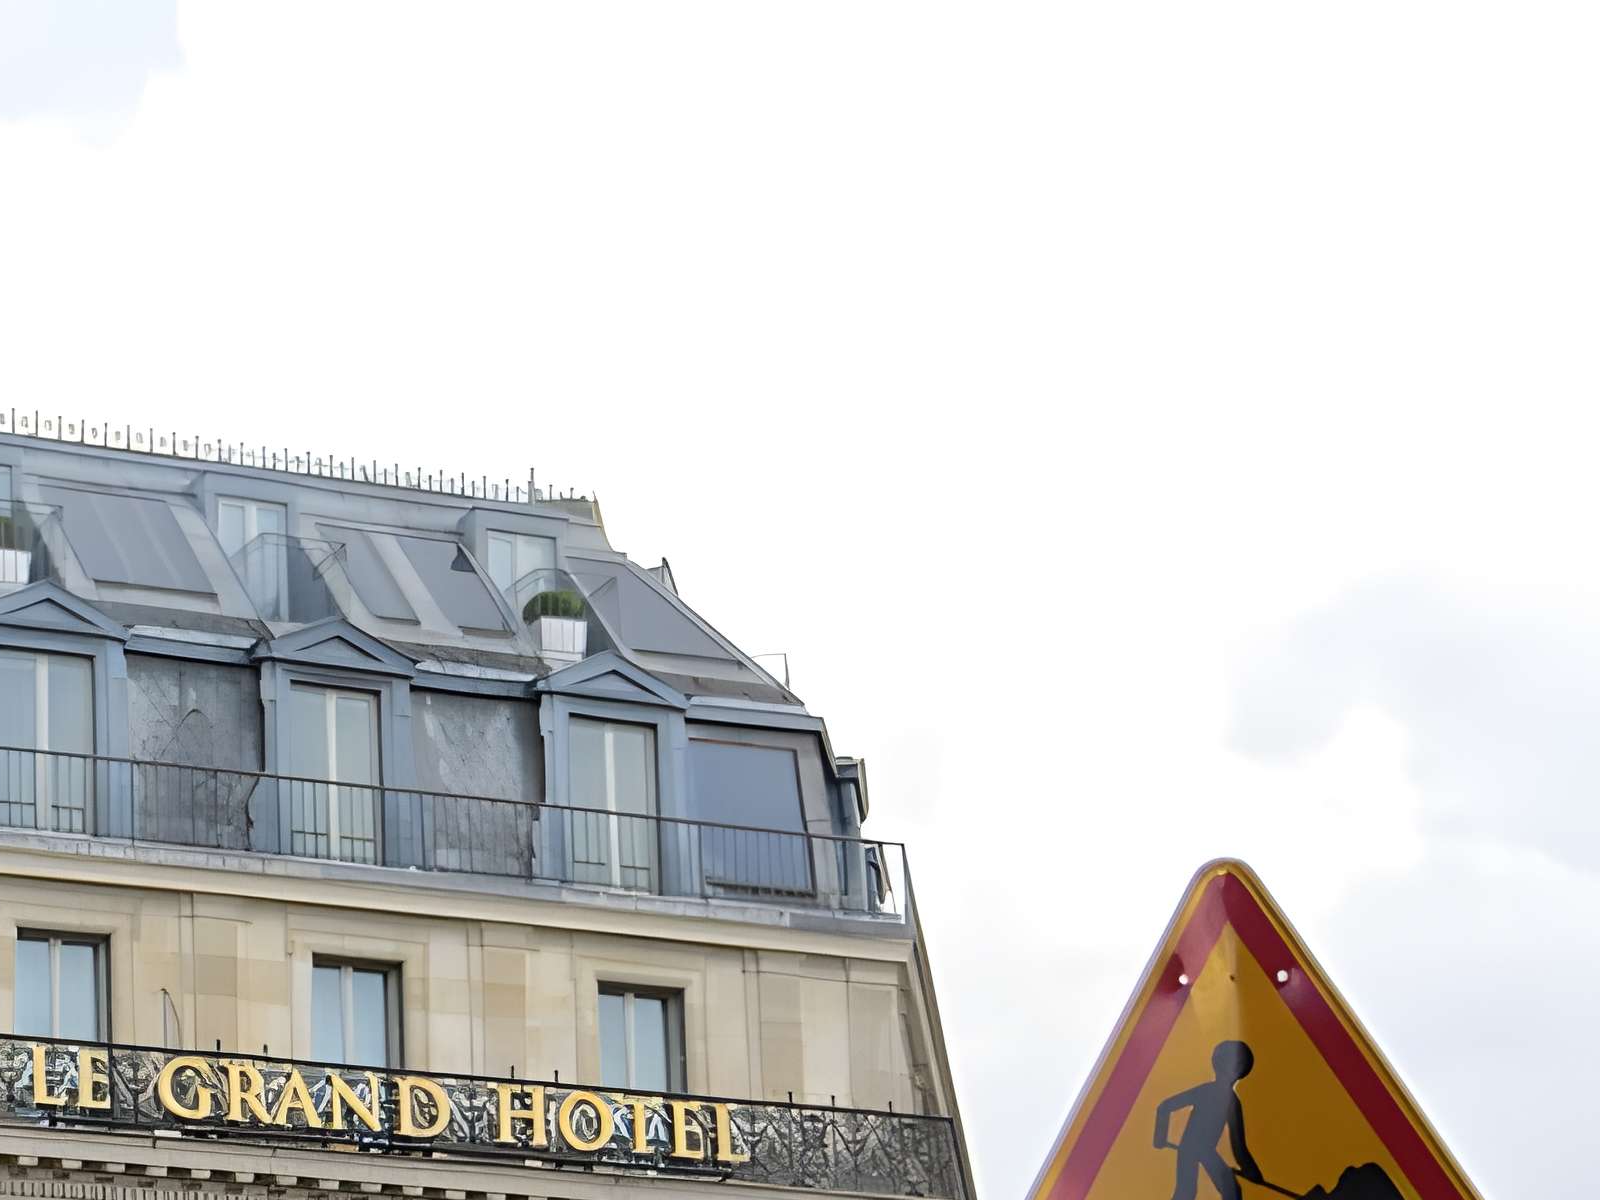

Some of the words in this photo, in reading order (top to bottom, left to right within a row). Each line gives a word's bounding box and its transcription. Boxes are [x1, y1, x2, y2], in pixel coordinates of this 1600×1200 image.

[32, 1044, 112, 1110] LE
[158, 1055, 450, 1140] GRAND
[496, 1084, 751, 1164] HOTEL
